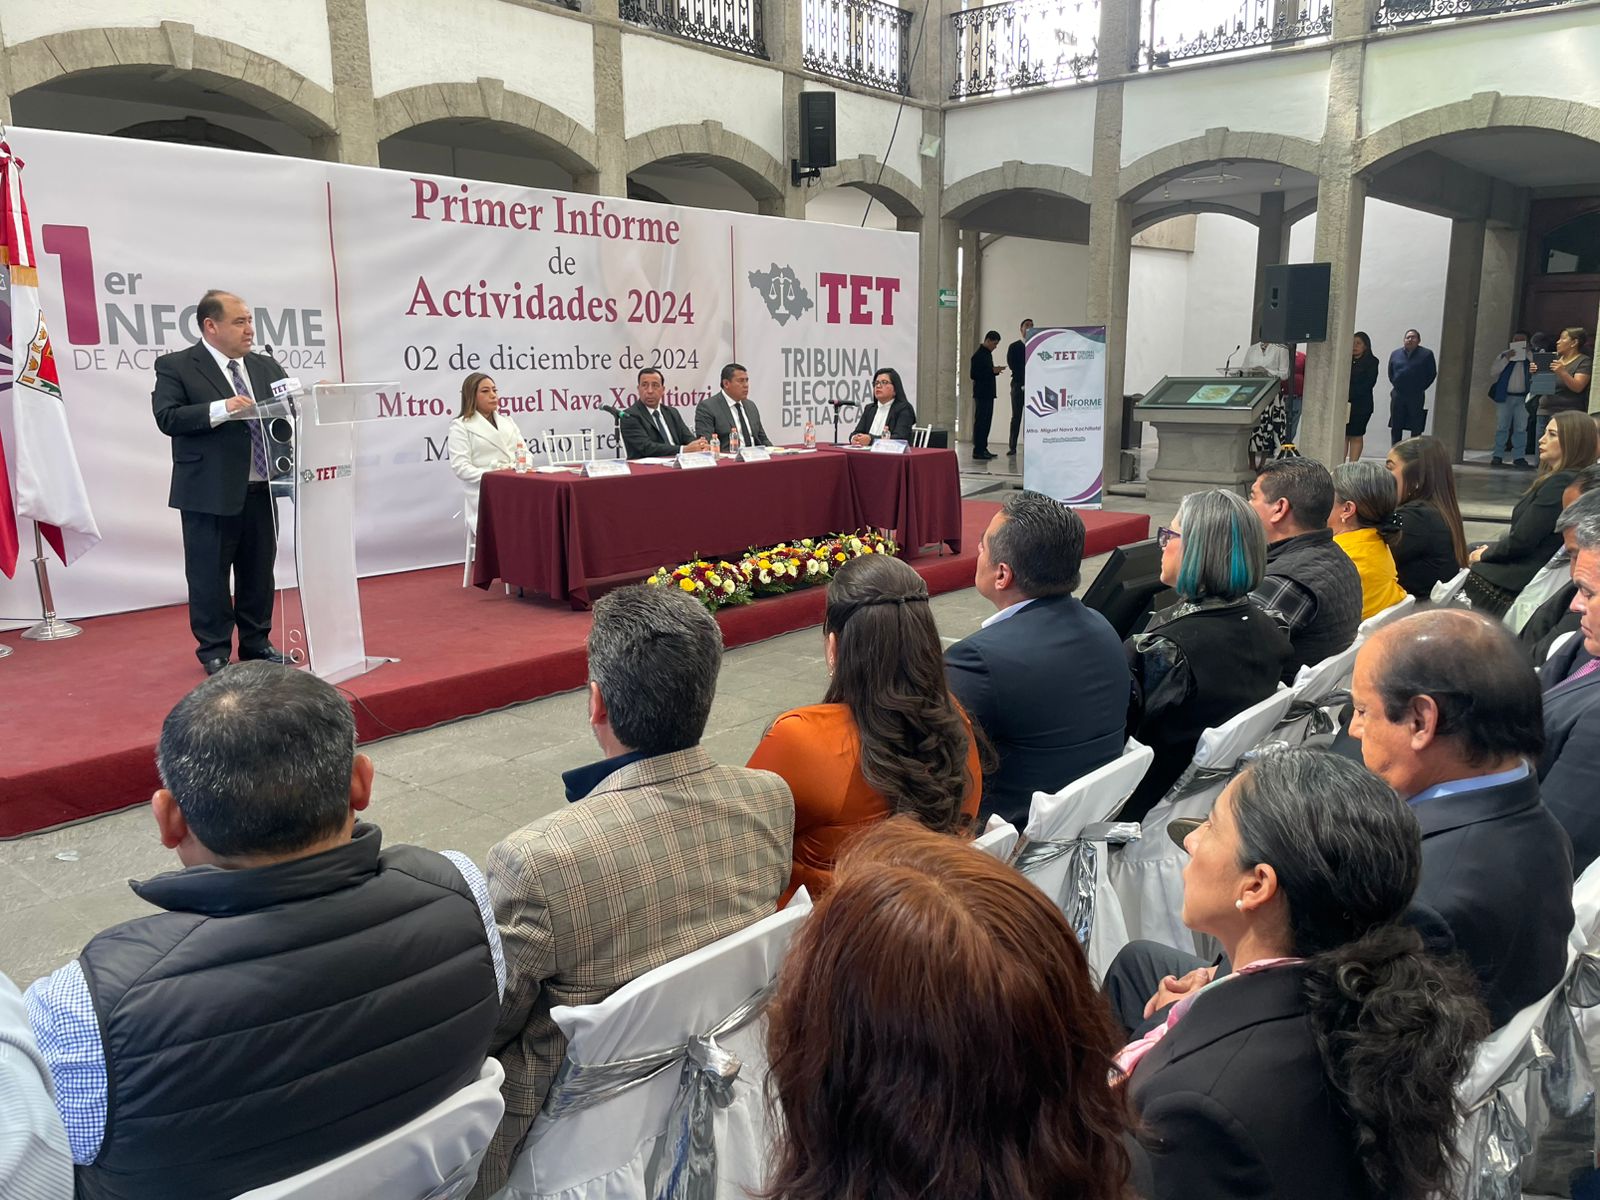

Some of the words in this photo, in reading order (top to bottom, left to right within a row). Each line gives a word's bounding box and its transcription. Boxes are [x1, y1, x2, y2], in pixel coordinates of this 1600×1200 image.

[410, 178, 543, 231] Primer
[552, 196, 680, 244] Informe
[548, 246, 576, 275] de
[405, 276, 618, 323] Actividades
[627, 289, 695, 324] 2024
[819, 272, 900, 325] TET
[104, 303, 326, 346] NFME
[73, 349, 108, 371] DE
[279, 350, 326, 369] 2024
[403, 345, 439, 371] 02
[448, 343, 481, 370] de
[489, 344, 612, 370] diciembre
[619, 346, 644, 370] de
[649, 348, 699, 370] 2024
[1054, 351, 1077, 361] TET
[272, 383, 287, 395] TET
[376, 391, 453, 418] Mtro.
[498, 388, 544, 416] guel
[550, 388, 602, 412] Nava
[609, 385, 712, 409] Xotiotzi
[782, 380, 874, 406] ELECTORA
[782, 407, 802, 428] DE
[806, 405, 863, 425] TLACA
[316, 466, 337, 480] TET
